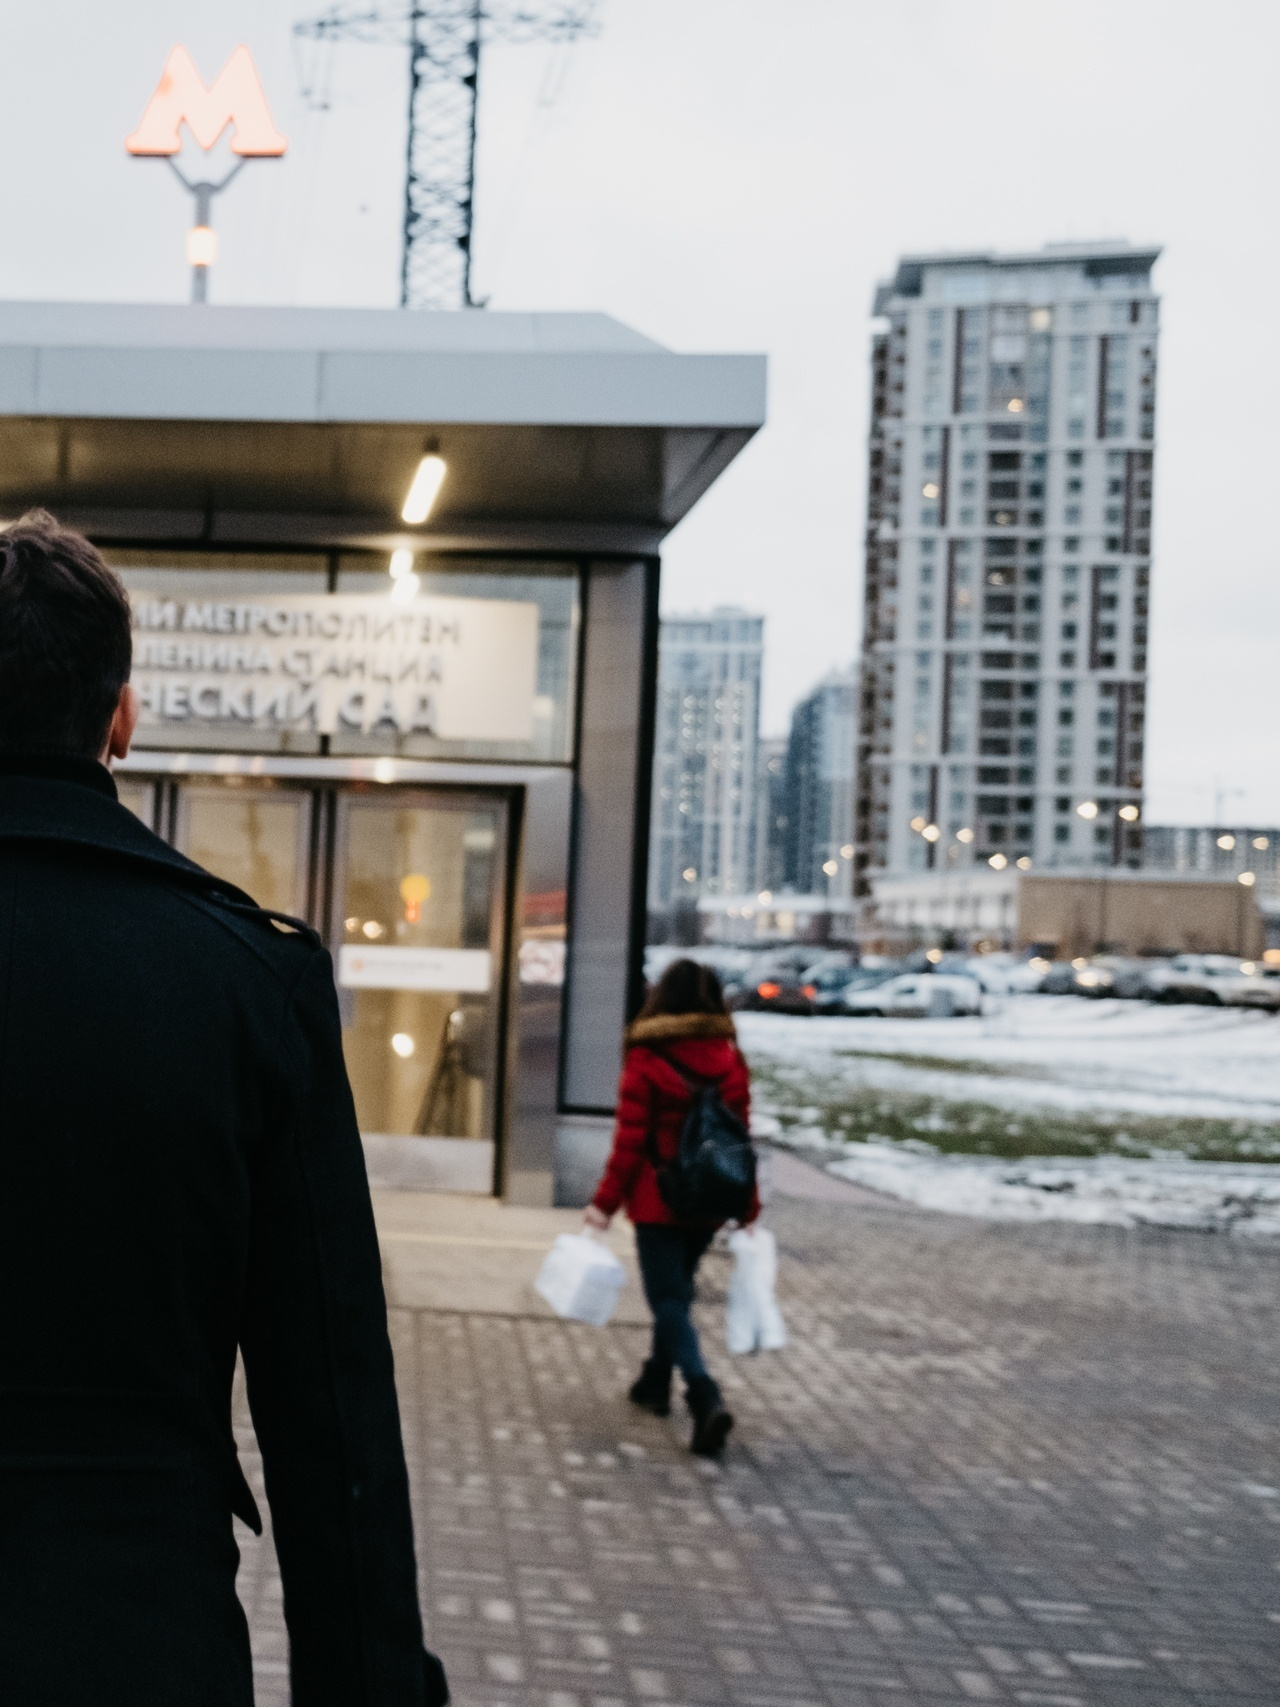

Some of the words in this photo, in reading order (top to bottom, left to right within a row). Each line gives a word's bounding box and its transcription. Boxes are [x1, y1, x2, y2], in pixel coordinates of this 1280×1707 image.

[182, 602, 460, 645] МЕТРОПОЛИТЕН
[280, 649, 444, 685] СТАНЦИЯ
[133, 680, 320, 727] ЧЕСКИЙ
[337, 690, 437, 734] САД
